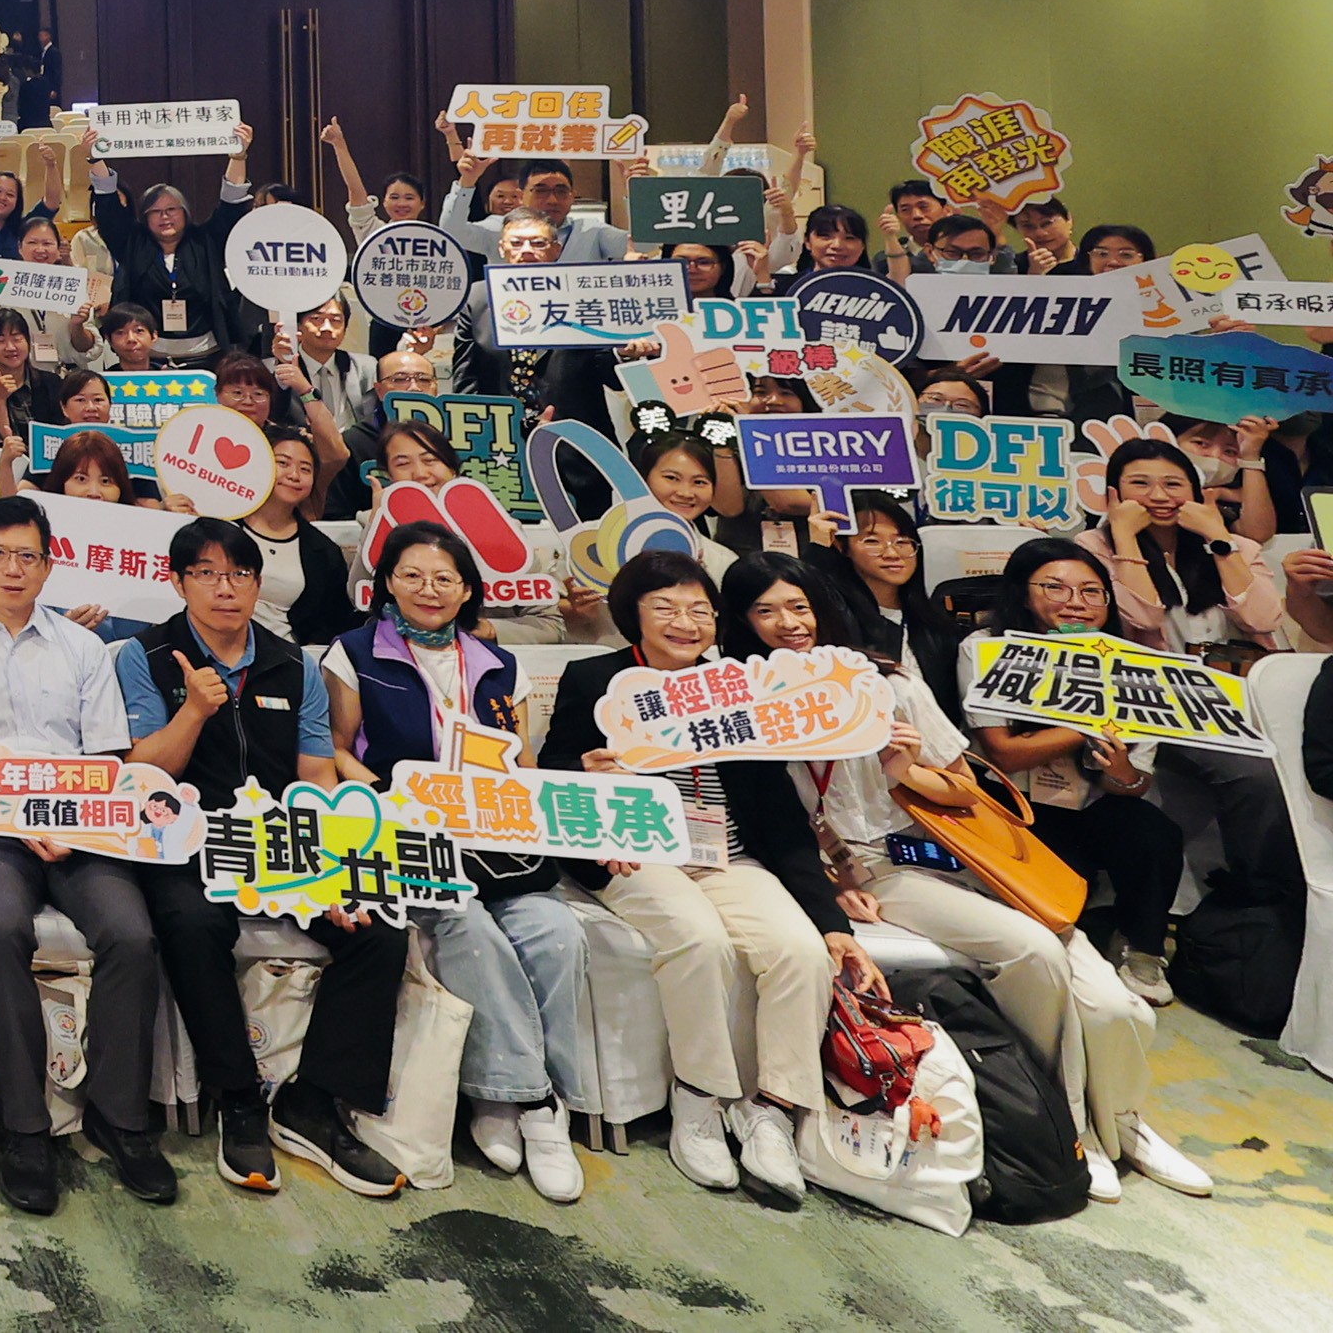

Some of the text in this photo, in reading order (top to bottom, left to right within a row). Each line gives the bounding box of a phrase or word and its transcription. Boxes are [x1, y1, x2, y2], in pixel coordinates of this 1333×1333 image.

[95, 106, 234, 127] 車用沖床件專家
[455, 91, 603, 119] 人才回任
[113, 136, 239, 150] 碩隆精密工業股份有限公司
[481, 123, 596, 153] 再就業
[926, 107, 1024, 165] 職涯
[939, 134, 1060, 199] 再發光
[653, 189, 740, 231] 里仁
[245, 241, 327, 263] ATEN
[379, 236, 447, 257] ATEN
[13, 269, 81, 292] 碩隆精密
[247, 264, 329, 278] 宏正自動科技
[371, 256, 455, 275] 新北市政府
[10, 285, 77, 306] Shou Long
[362, 271, 463, 291] 友善職場認證
[501, 276, 561, 292] ATEN
[576, 274, 674, 290] 宏正自動科技
[539, 297, 680, 328] 友善職場
[697, 300, 801, 340] DFI
[806, 291, 896, 324] AEWIN
[939, 295, 1111, 348] AEWIN
[733, 343, 837, 377] 一級棒
[1128, 352, 1333, 396] 長照有真承
[108, 403, 199, 428] 經驗傳
[393, 399, 515, 453] DFI
[752, 430, 892, 458] MERRY
[936, 420, 1069, 479] DFI
[162, 452, 255, 501] MOS BURGER
[935, 478, 1072, 521] 很可以
[482, 579, 553, 602] RGER
[633, 663, 755, 724] 讓經驗
[975, 643, 1263, 740] 職場無限
[688, 693, 839, 753] 持續發光
[0, 762, 110, 792] 年齡不同
[23, 798, 134, 828] 價值相同
[406, 772, 676, 851] 經驗傳承
[206, 807, 464, 923] 青銀共融
